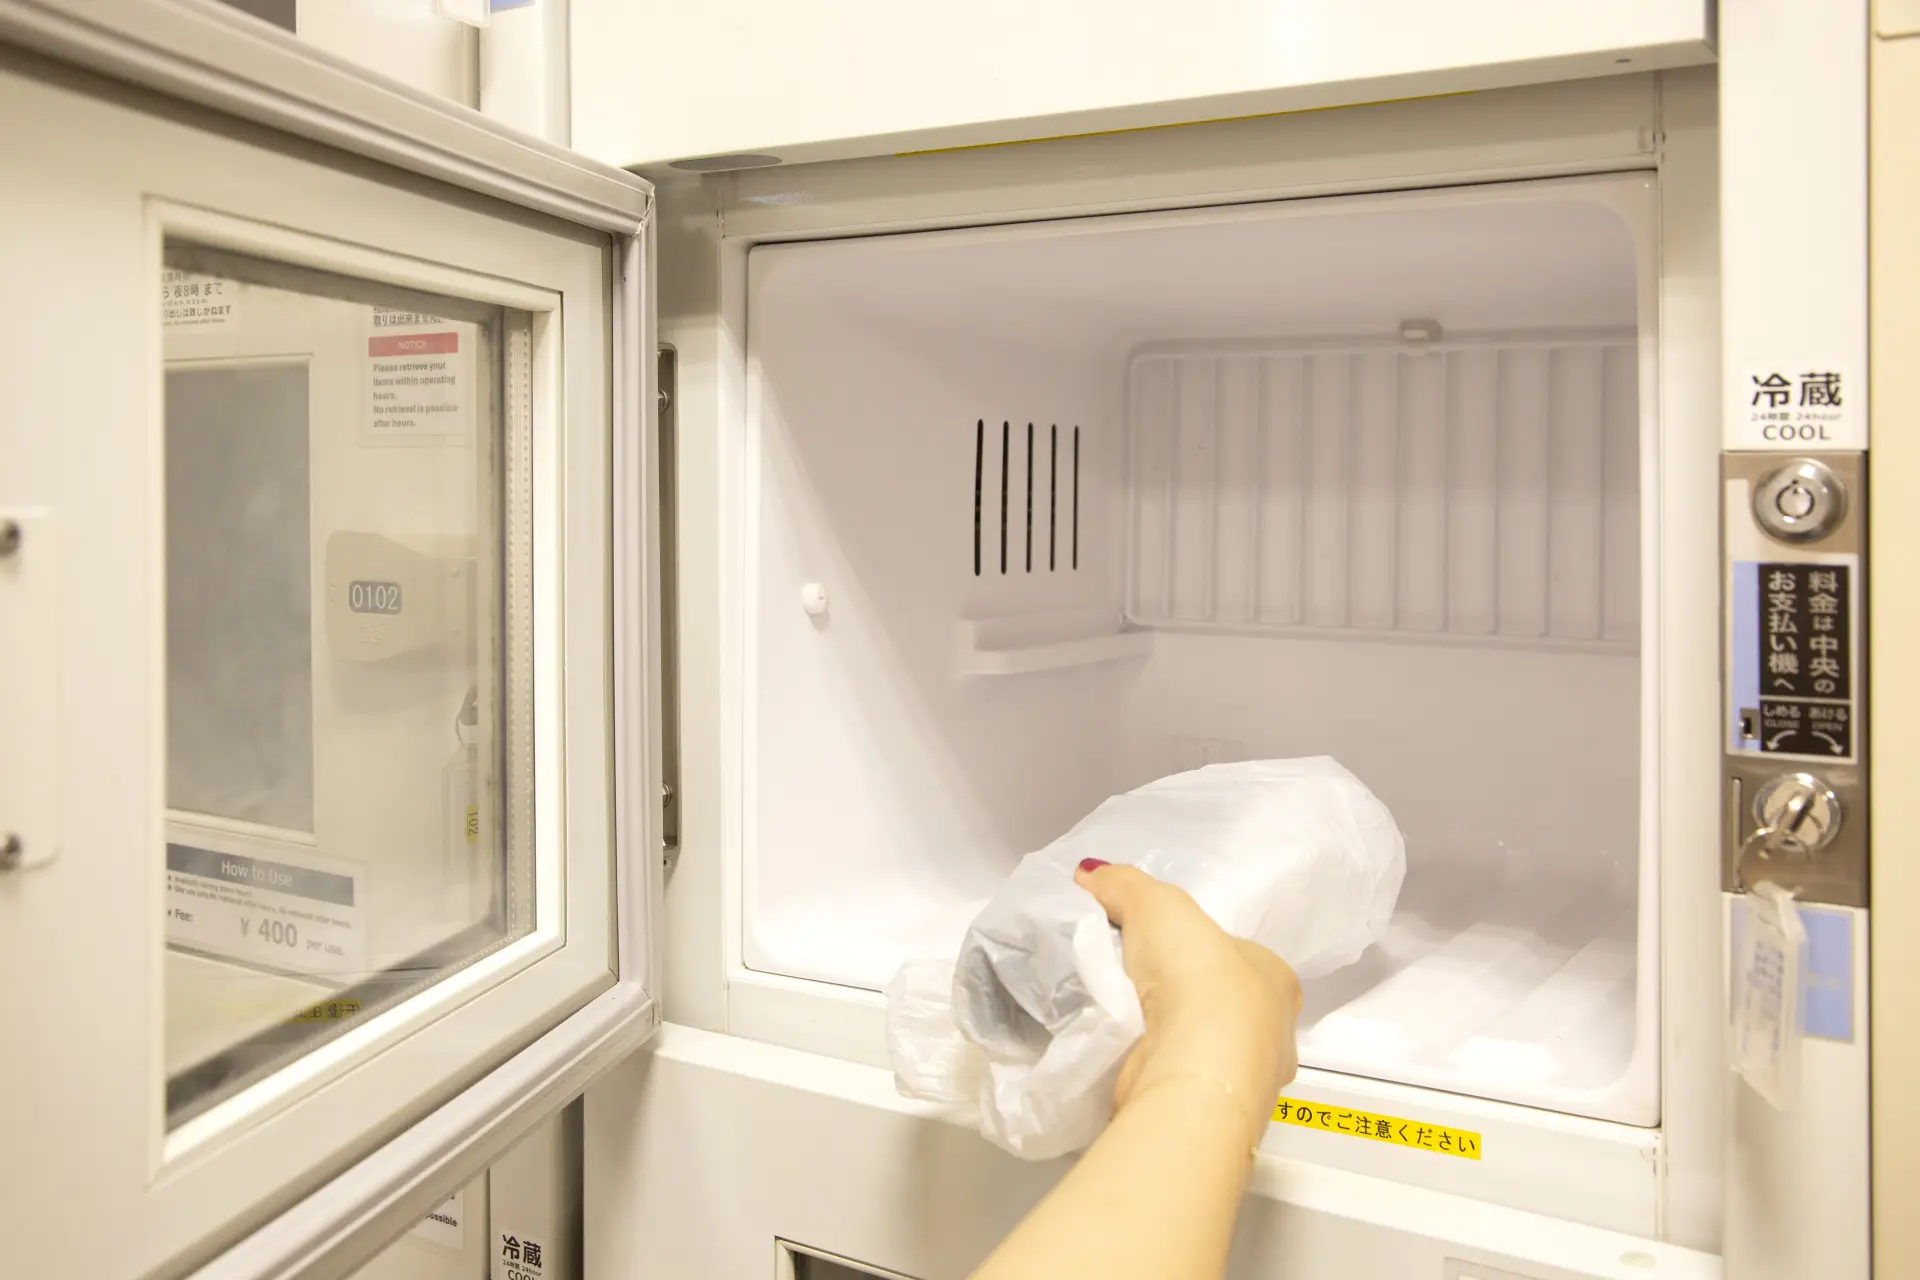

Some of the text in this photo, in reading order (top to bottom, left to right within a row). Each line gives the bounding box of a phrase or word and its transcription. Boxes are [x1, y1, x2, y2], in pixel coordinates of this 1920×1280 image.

[398, 340, 427, 350] NOTICE
[373, 361, 446, 372] Please retrieve your
[373, 375, 456, 386] items within operating
[373, 392, 397, 401] hours.
[1751, 371, 1842, 408] 冷蔵
[374, 405, 384, 414] No
[385, 404, 416, 414] retrieval
[418, 403, 424, 413] is
[373, 418, 416, 428] after hours.
[1762, 424, 1831, 441] COOL
[352, 584, 399, 610] 0102
[1768, 570, 1798, 691] お支払い機へ
[1808, 571, 1840, 694] 料金は中央の
[1763, 704, 1801, 719] しめる
[221, 860, 249, 877] How
[252, 865, 265, 881] to
[269, 868, 293, 888] Use
[176, 908, 193, 922] Fee:
[258, 918, 298, 948] 400
[306, 939, 322, 951] per
[324, 943, 345, 956] use.
[1277, 1101, 1476, 1153] すのでご注意ください
[502, 1234, 542, 1269] 冷蔵
[507, 1269, 535, 1280] CO
